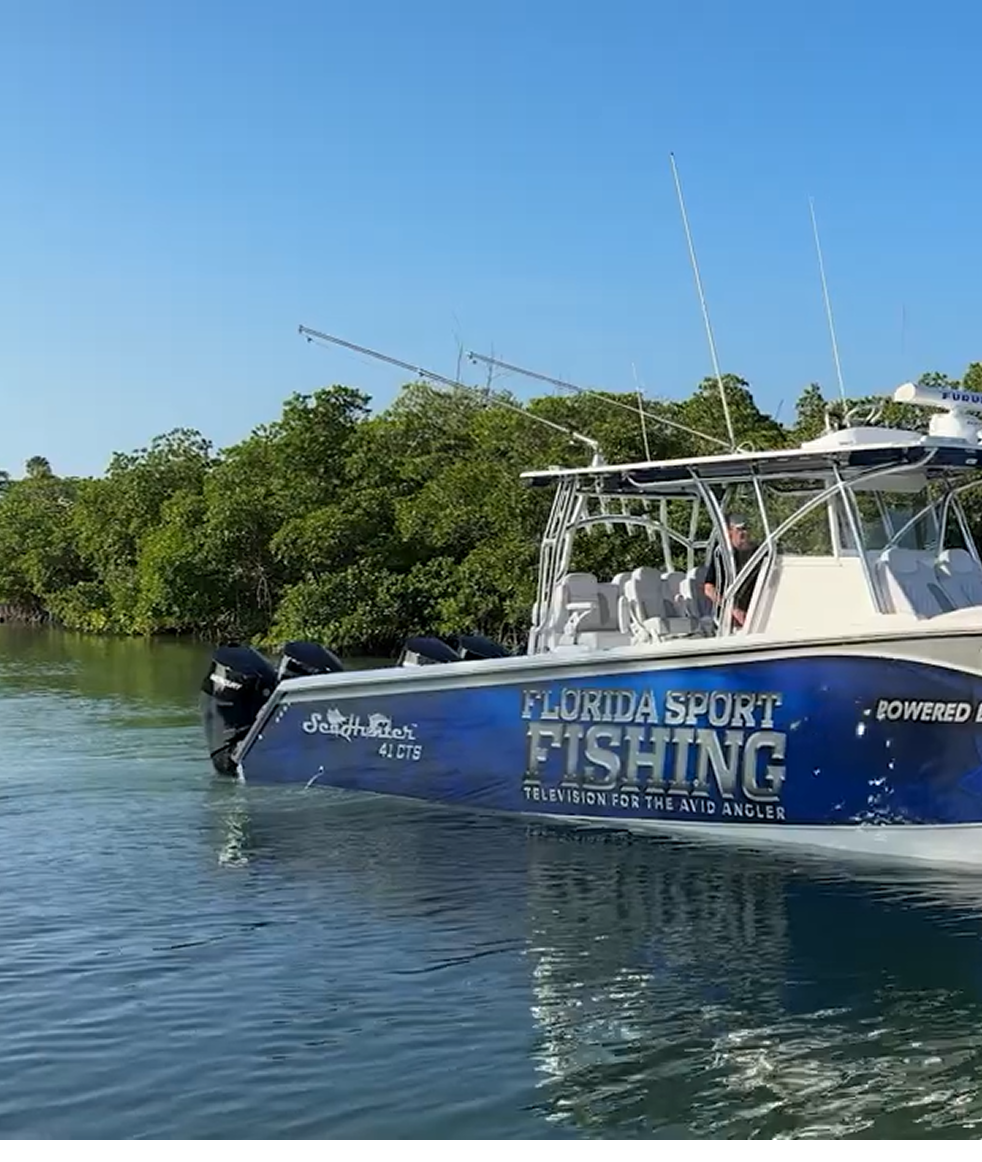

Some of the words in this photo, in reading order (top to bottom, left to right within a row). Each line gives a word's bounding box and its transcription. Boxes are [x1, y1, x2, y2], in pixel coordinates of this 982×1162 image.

[521, 687, 658, 724] FLORIDA
[665, 689, 782, 729] SPORT
[876, 700, 971, 723] POWERED
[379, 743, 392, 758] 41
[397, 744, 422, 760] CTS
[523, 722, 787, 803] FISHING
[524, 787, 606, 807] TELEVISION
[612, 793, 640, 810] FOR
[645, 796, 674, 811] THE
[680, 799, 717, 814] AVID
[722, 801, 786, 820] ANGLER
